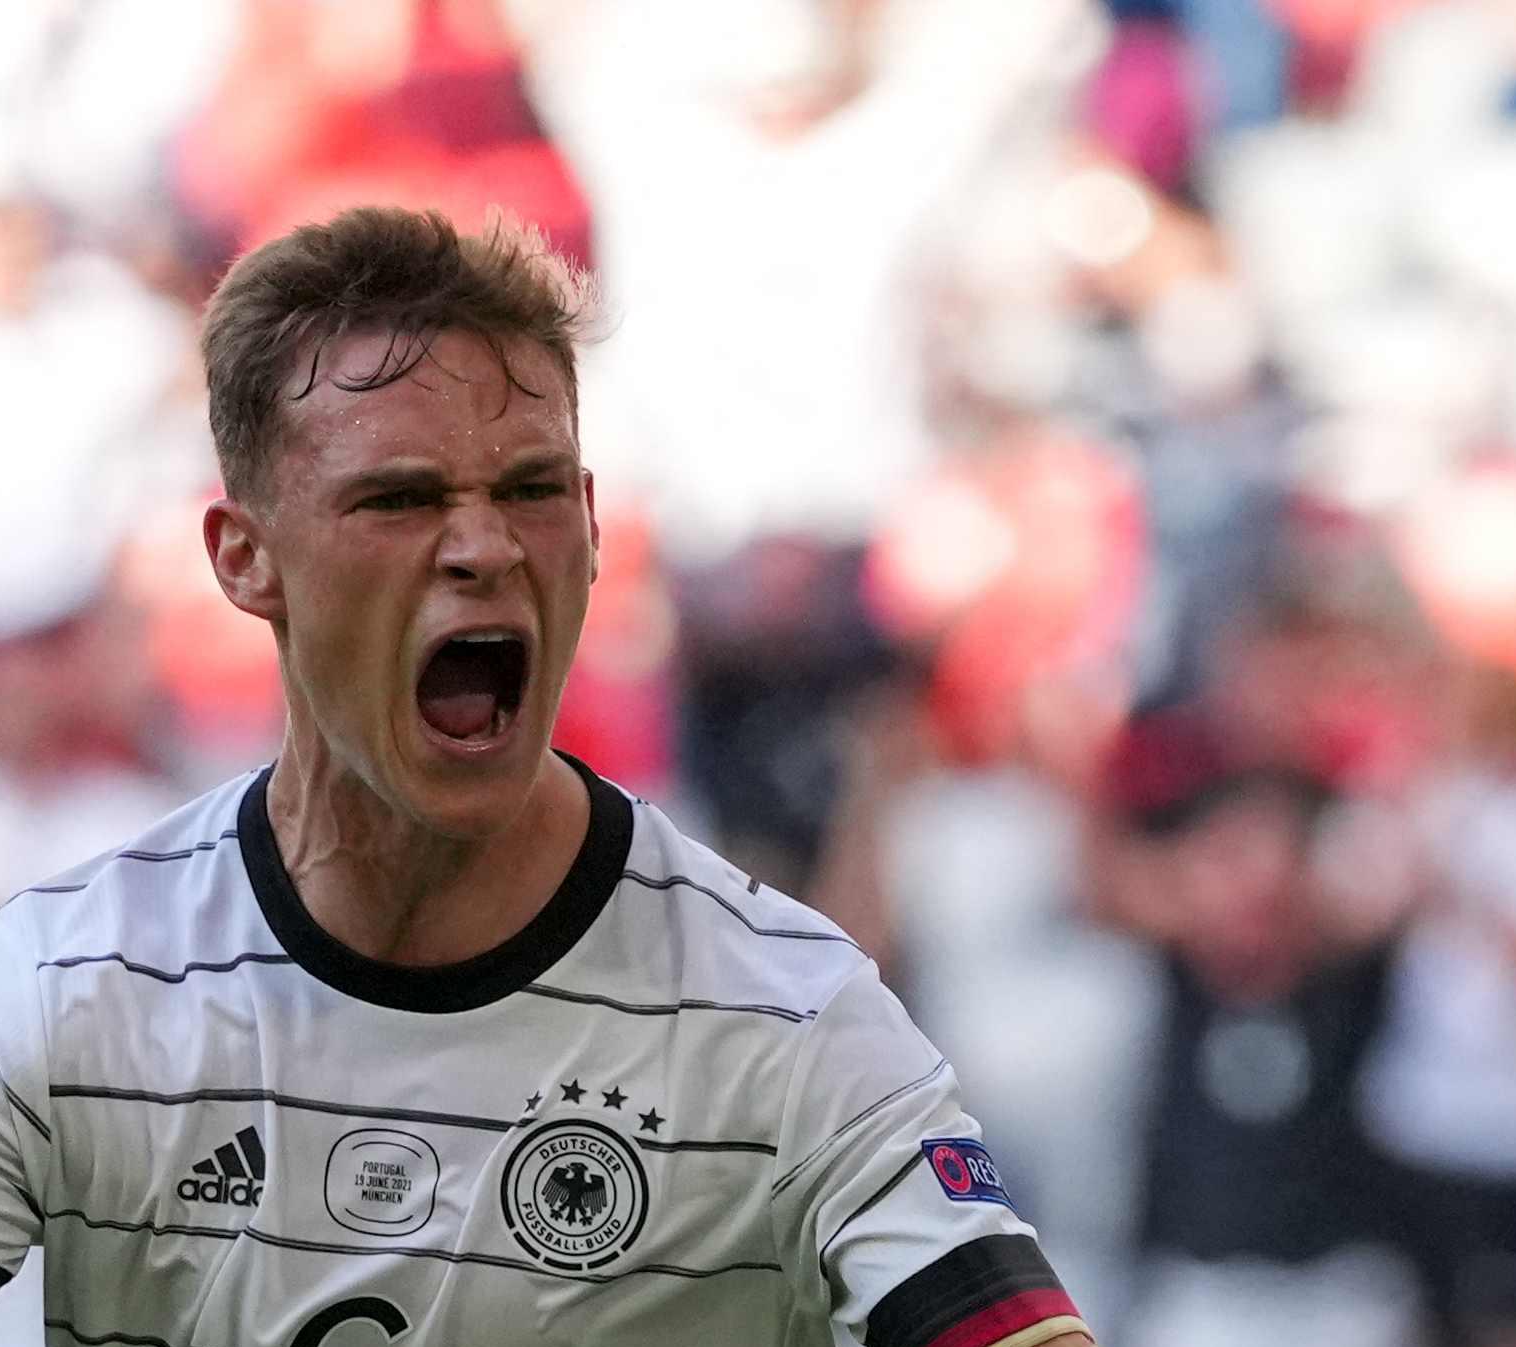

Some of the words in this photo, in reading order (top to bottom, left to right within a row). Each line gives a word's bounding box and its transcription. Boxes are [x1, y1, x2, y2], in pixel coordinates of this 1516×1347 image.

[538, 1137, 622, 1174] DEUTSCHER
[363, 1161, 405, 1176] PORTUGAL
[355, 1174, 364, 1186] 19
[367, 1175, 389, 1188] JUNE
[392, 1179, 411, 1191] 2021
